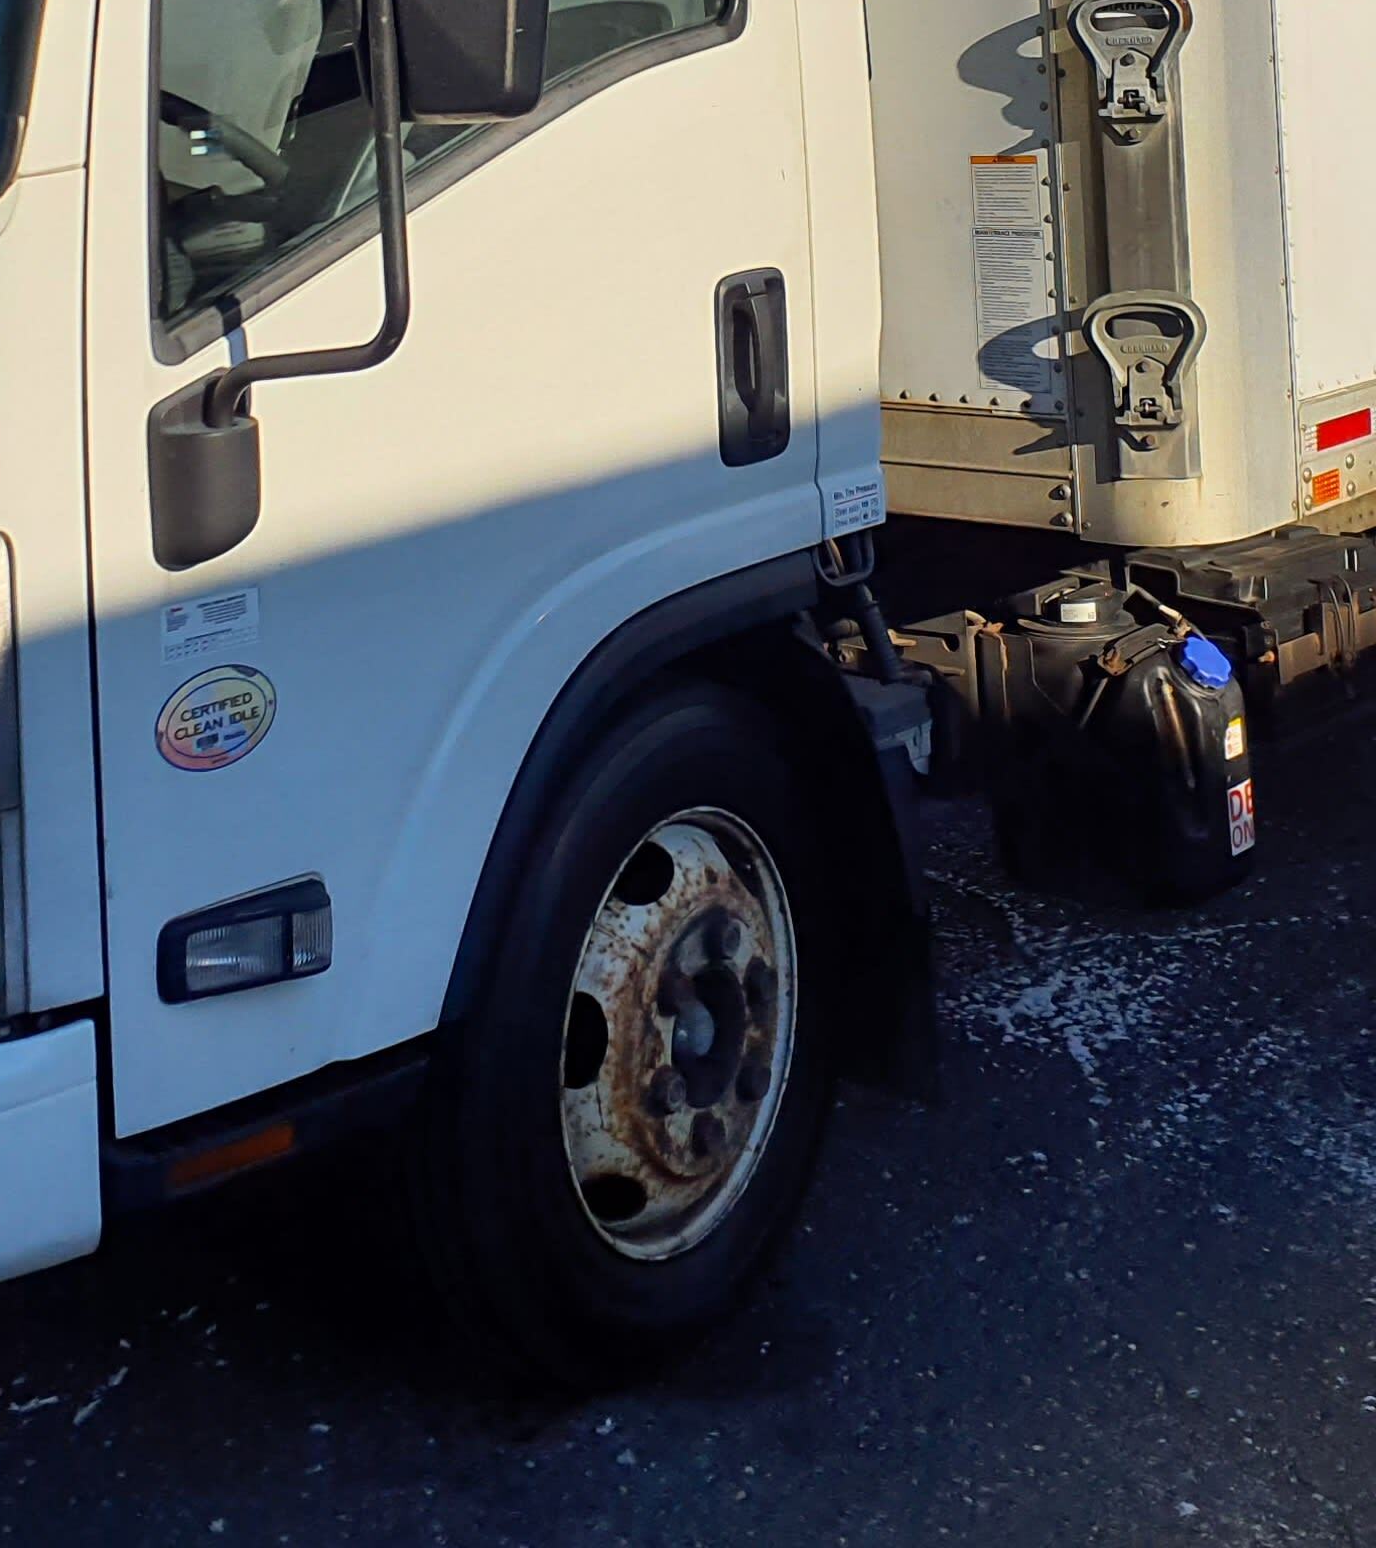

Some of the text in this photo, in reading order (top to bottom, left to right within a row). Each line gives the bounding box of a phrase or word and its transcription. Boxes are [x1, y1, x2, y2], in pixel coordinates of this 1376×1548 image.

[180, 691, 253, 722] CERTIFIED
[174, 717, 224, 741] CLEAN
[229, 706, 260, 725] IDLE
